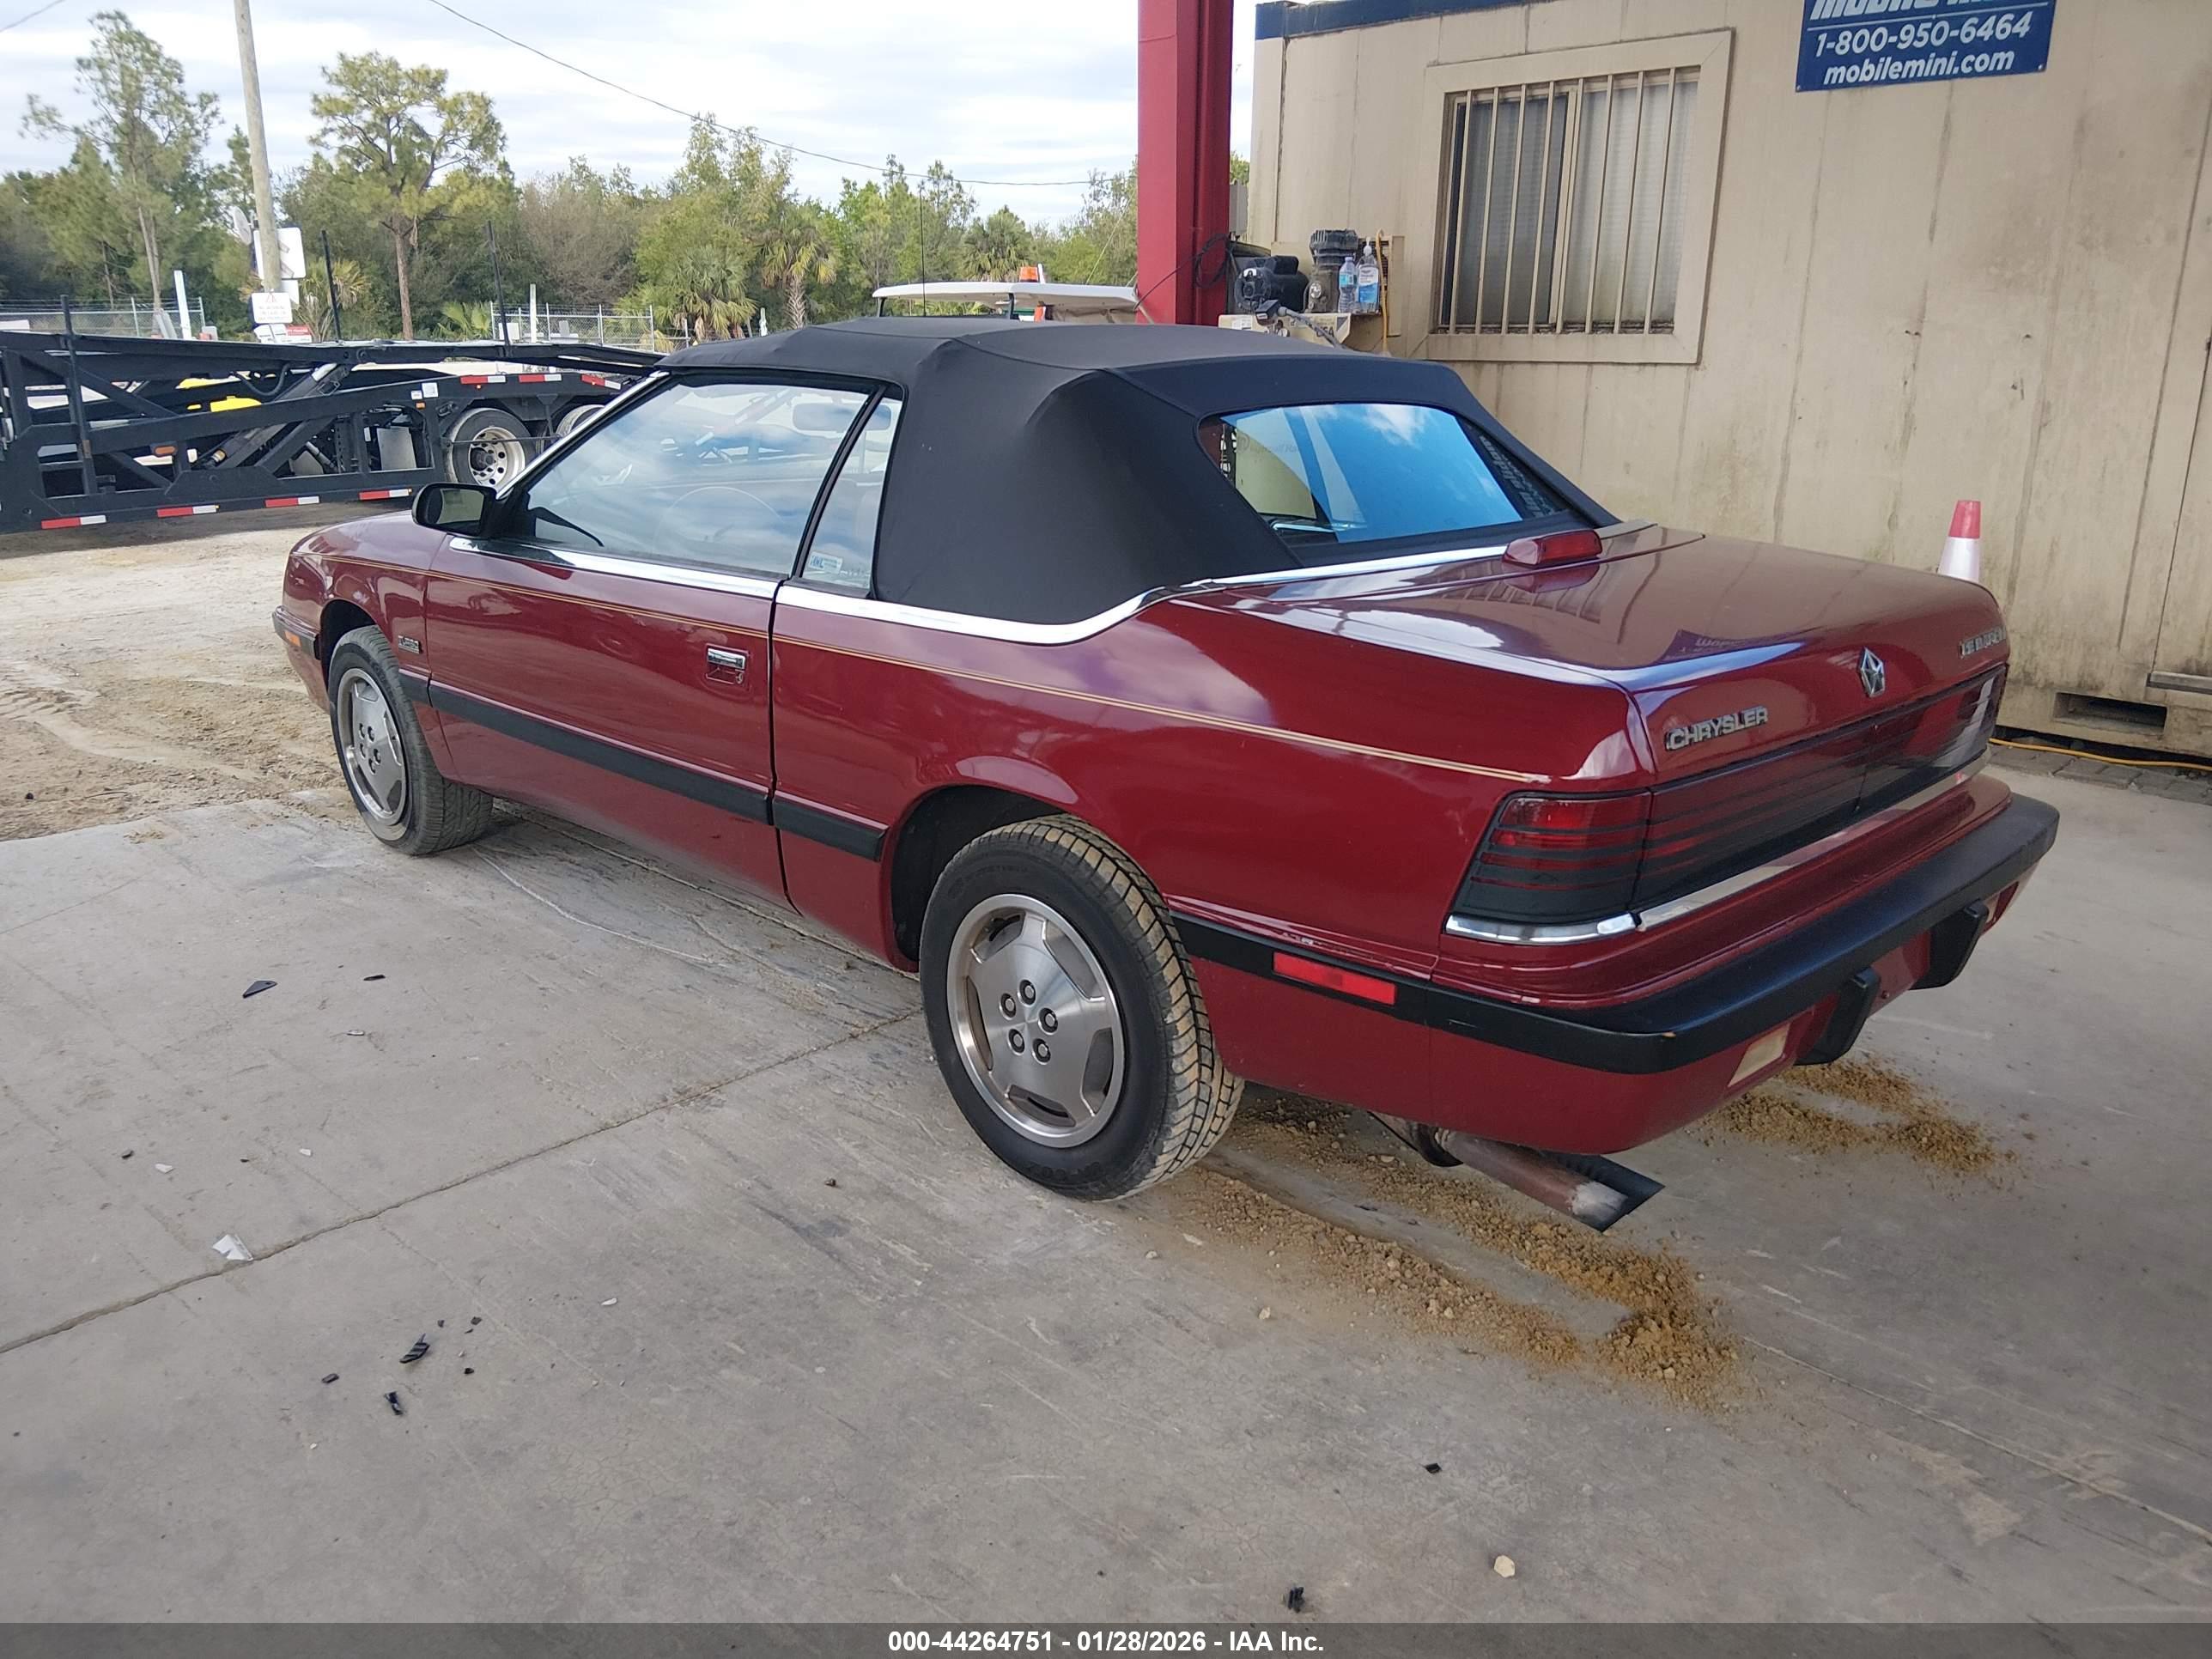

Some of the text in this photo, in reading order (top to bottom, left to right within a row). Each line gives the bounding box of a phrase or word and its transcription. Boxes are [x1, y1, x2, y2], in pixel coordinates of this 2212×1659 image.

[1815, 10, 2033, 58] 1-800-950-6464
[1823, 50, 2014, 85] mobilemini.com
[1666, 706, 1768, 750] CHRYSLER
